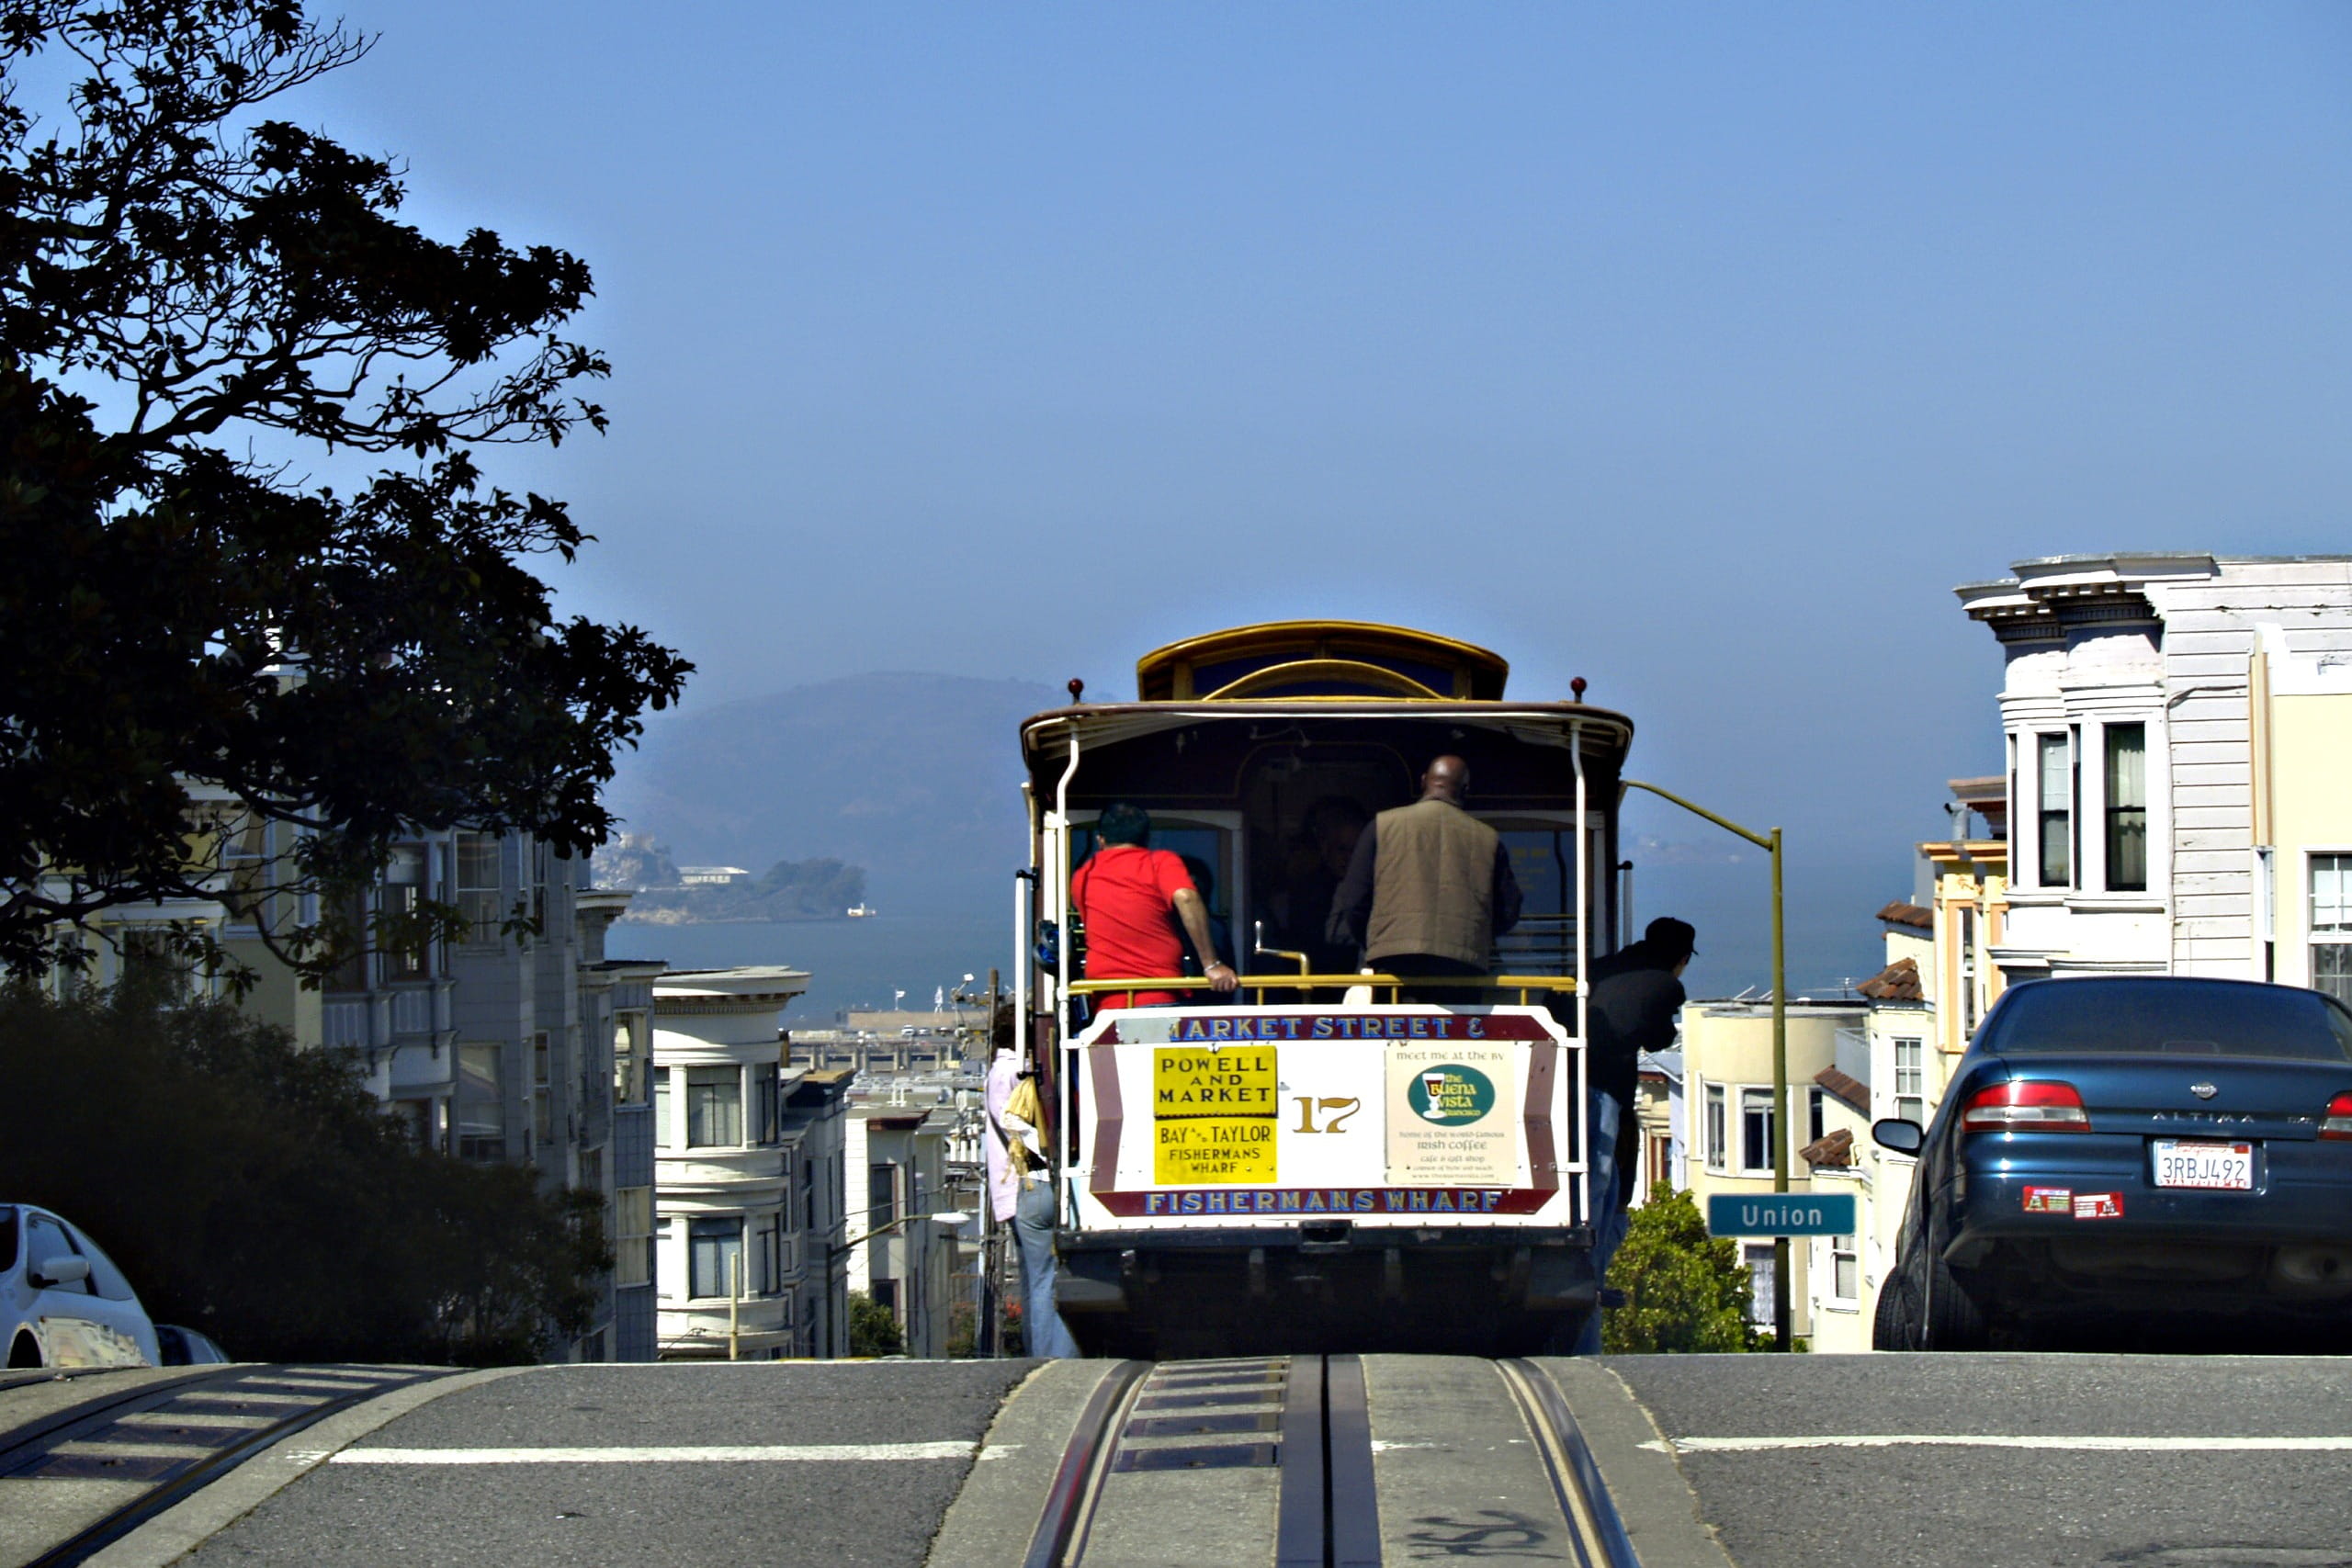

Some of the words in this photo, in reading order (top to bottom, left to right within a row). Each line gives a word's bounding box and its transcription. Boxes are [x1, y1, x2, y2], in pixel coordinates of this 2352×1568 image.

[1311, 1017, 1453, 1039] STREET
[1161, 1056, 1269, 1073] POWELL
[1190, 1074, 1243, 1086] AND
[1159, 1088, 1271, 1103] MARKET
[1292, 1096, 1361, 1134] 17
[2152, 1111, 2256, 1123] ALTIMA
[1160, 1126, 1188, 1144] BAY
[1211, 1125, 1271, 1143] TAYLOR
[1169, 1147, 1261, 1161] FISHERMANS
[1191, 1161, 1238, 1174] WHARF
[2163, 1157, 2245, 1181] 3RBJ492
[1146, 1190, 1376, 1215] FISHERMANS
[1384, 1190, 1503, 1212] WHARF
[1742, 1205, 1822, 1227] Union
